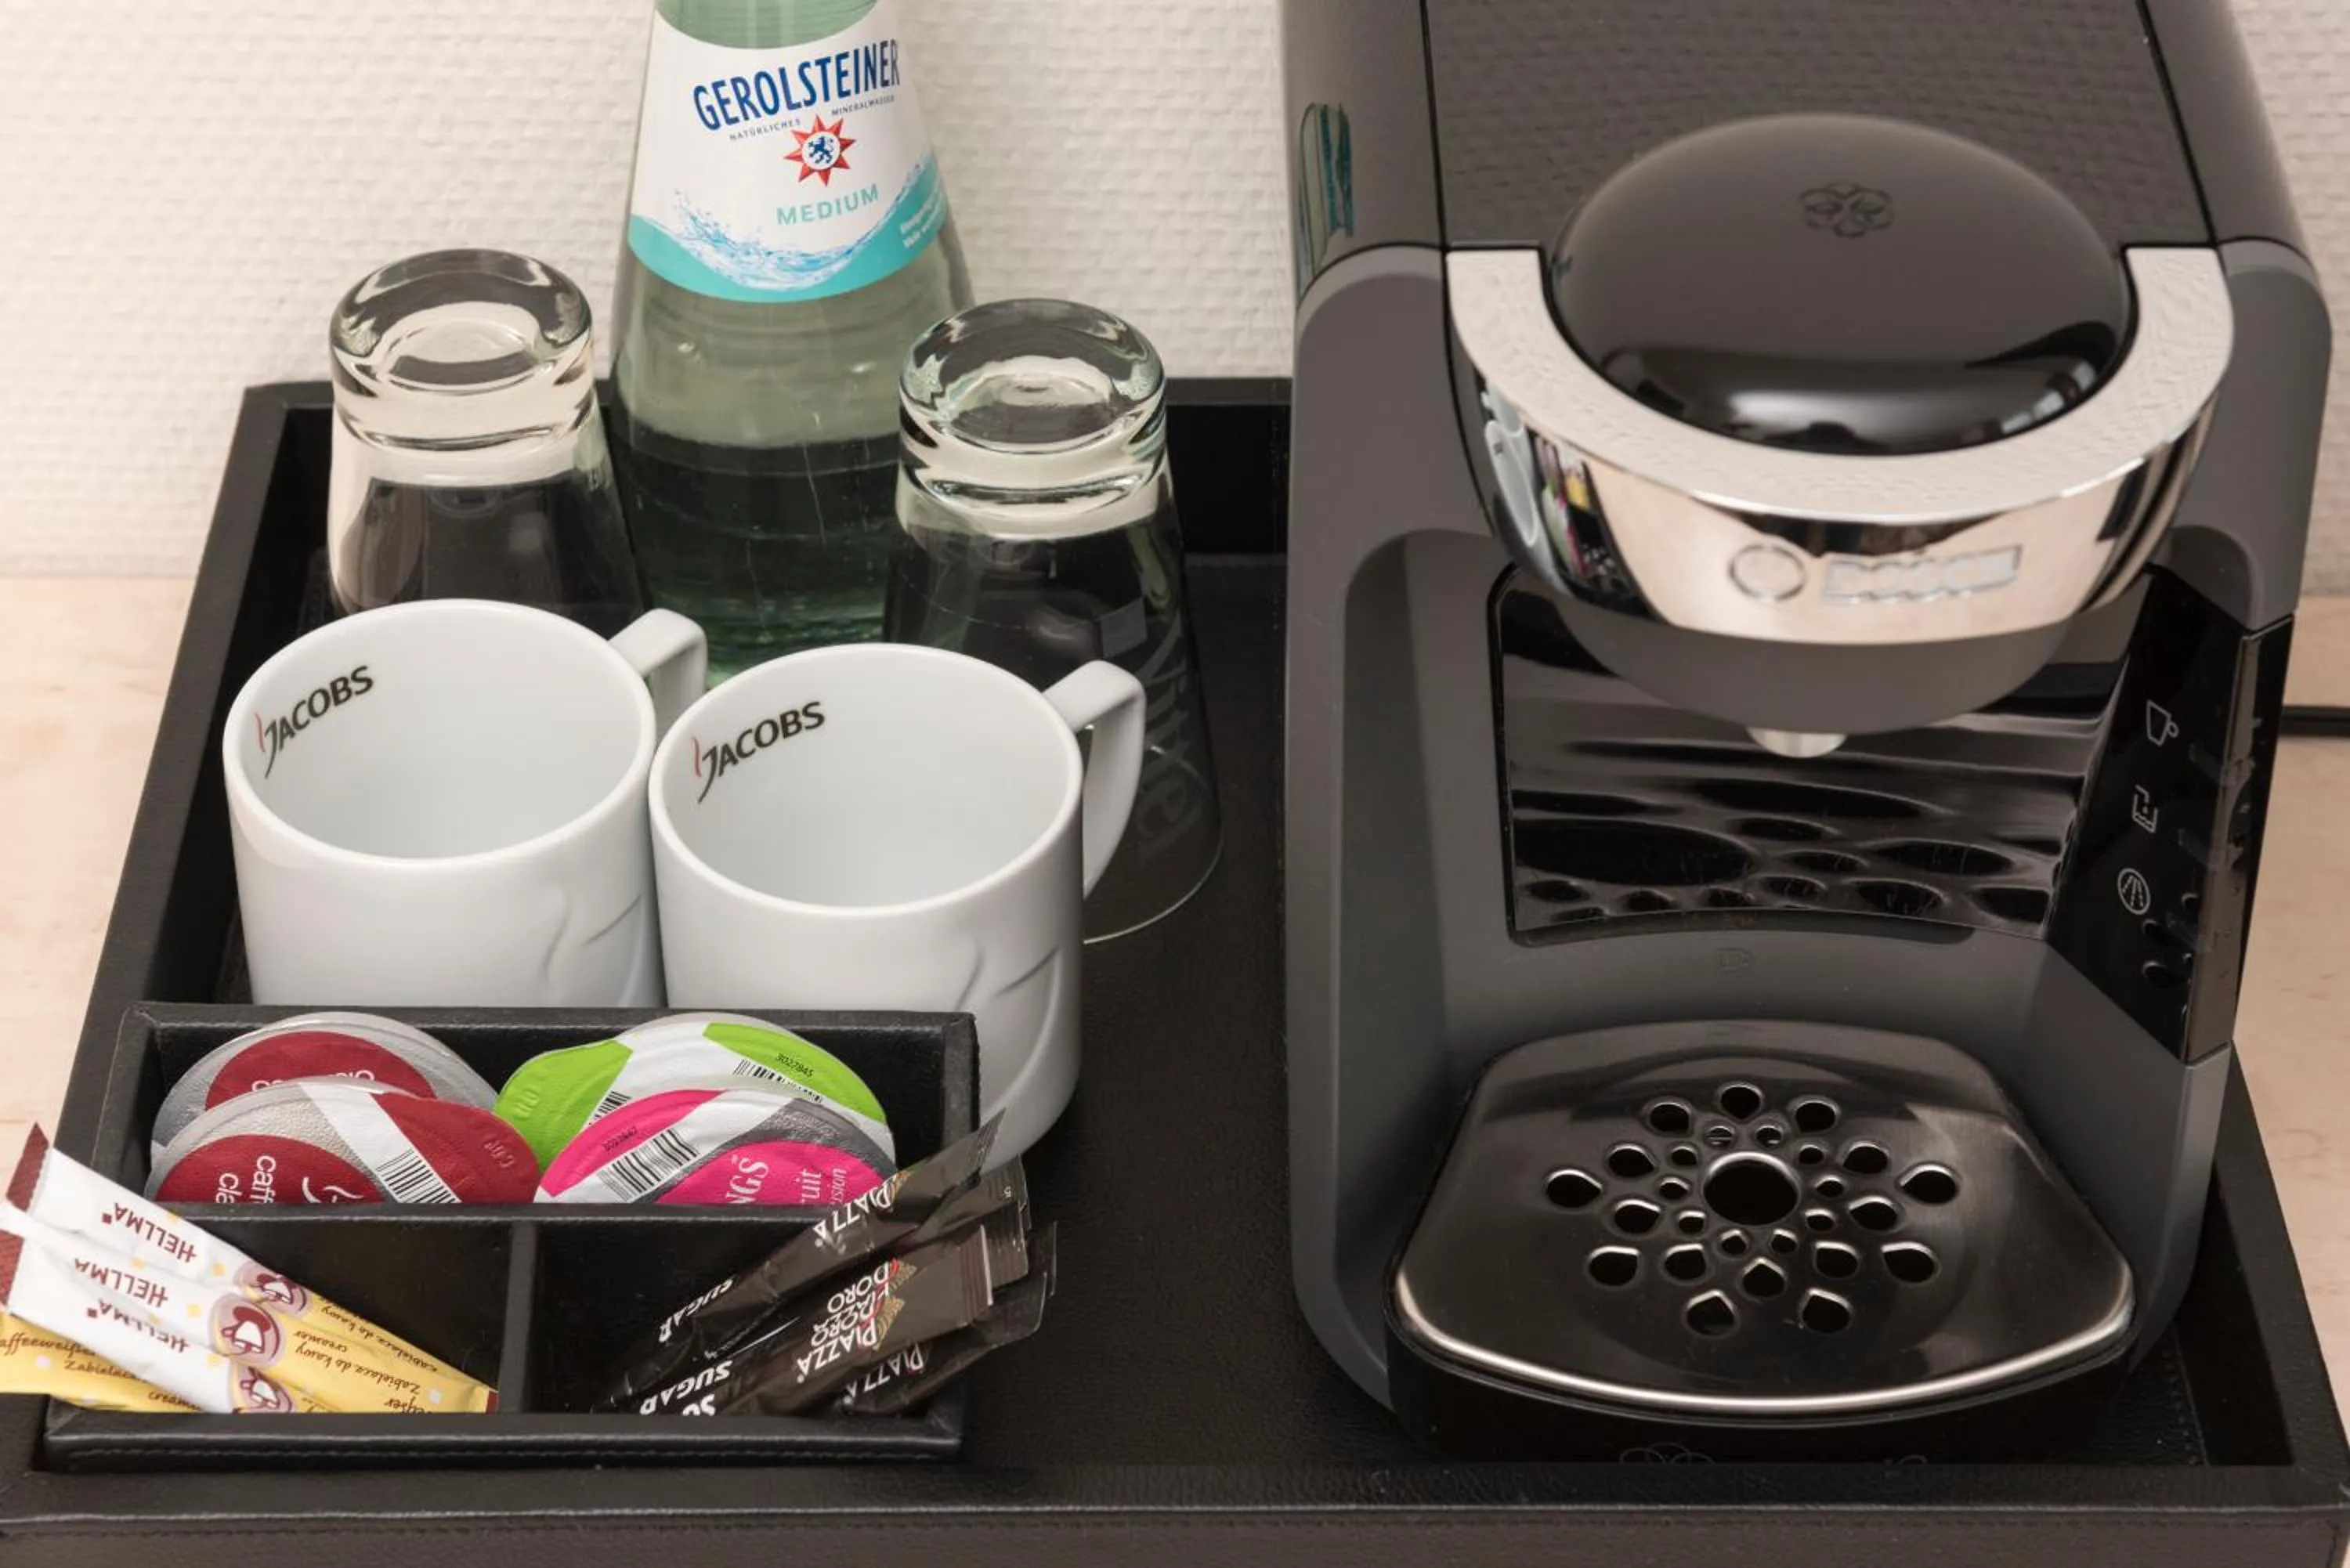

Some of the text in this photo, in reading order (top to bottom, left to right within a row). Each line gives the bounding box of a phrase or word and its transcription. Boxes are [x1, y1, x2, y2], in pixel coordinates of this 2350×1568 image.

[693, 39, 900, 131] GEROLSTEINER
[776, 183, 879, 226] MEDIUM
[263, 663, 375, 779] JACOBS
[696, 699, 827, 804] JACOBS
[215, 1172, 242, 1204] cla
[250, 1155, 276, 1204] caff
[726, 1157, 769, 1205] NGS
[795, 1168, 822, 1205] uit
[114, 1202, 197, 1263] HELLMA
[75, 1258, 168, 1309] HELLMA
[98, 1298, 189, 1353] HELLMA
[797, 1317, 877, 1377] PIAZZA
